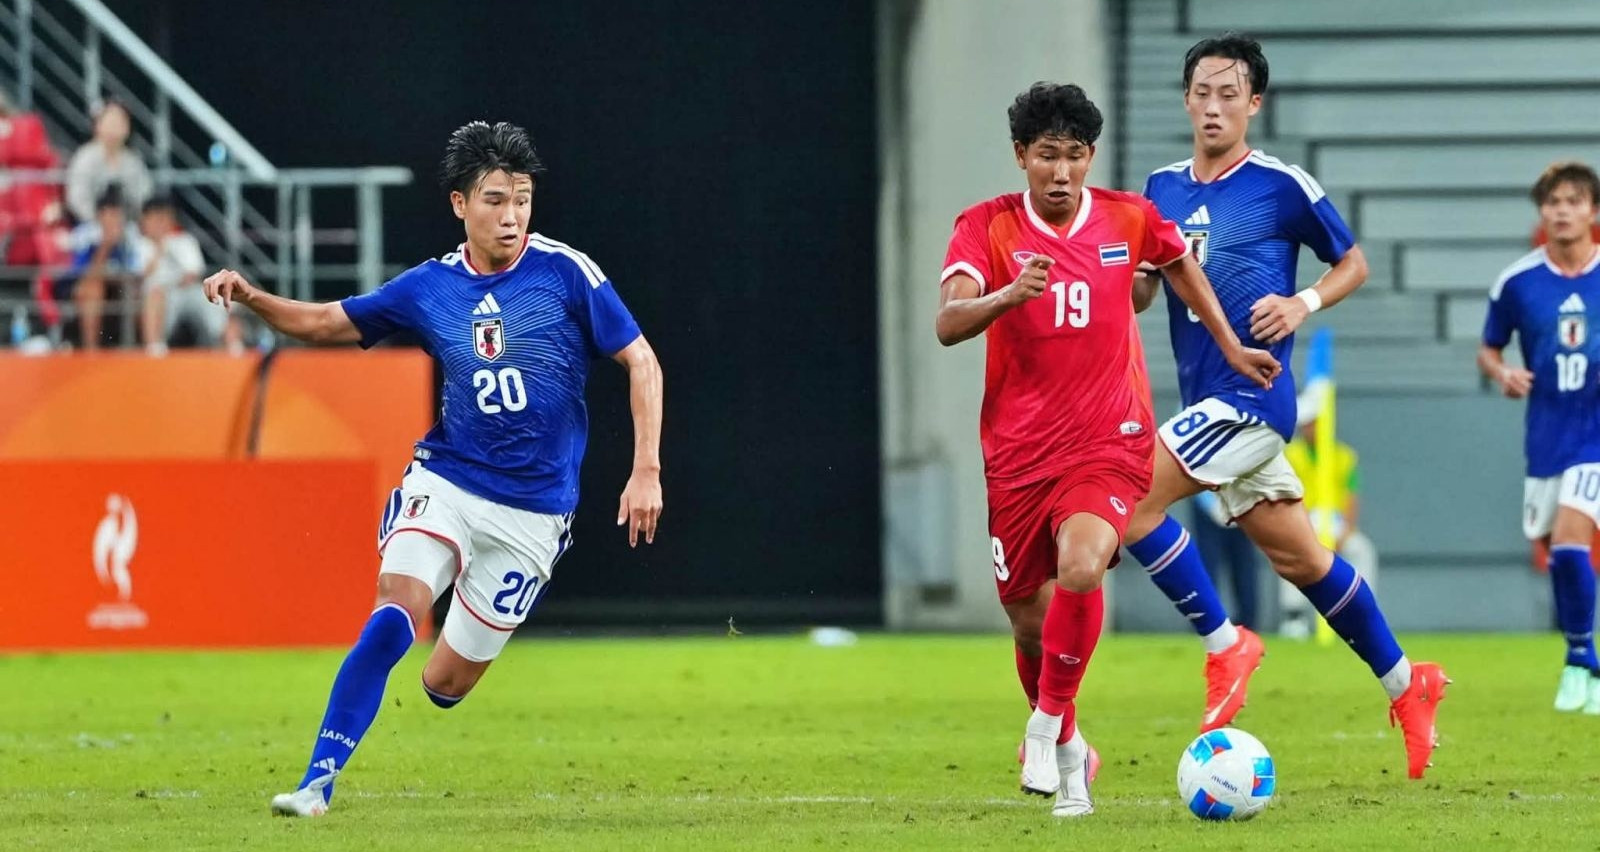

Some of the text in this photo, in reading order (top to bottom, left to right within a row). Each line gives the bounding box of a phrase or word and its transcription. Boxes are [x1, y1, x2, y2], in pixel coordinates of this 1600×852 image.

[1051, 281, 1090, 328] 19
[473, 367, 527, 414] 20
[1556, 352, 1588, 391] 10
[1172, 411, 1209, 437] 8
[1574, 470, 1600, 502] 10
[493, 571, 539, 617] 20
[320, 728, 357, 749] JAPAN
